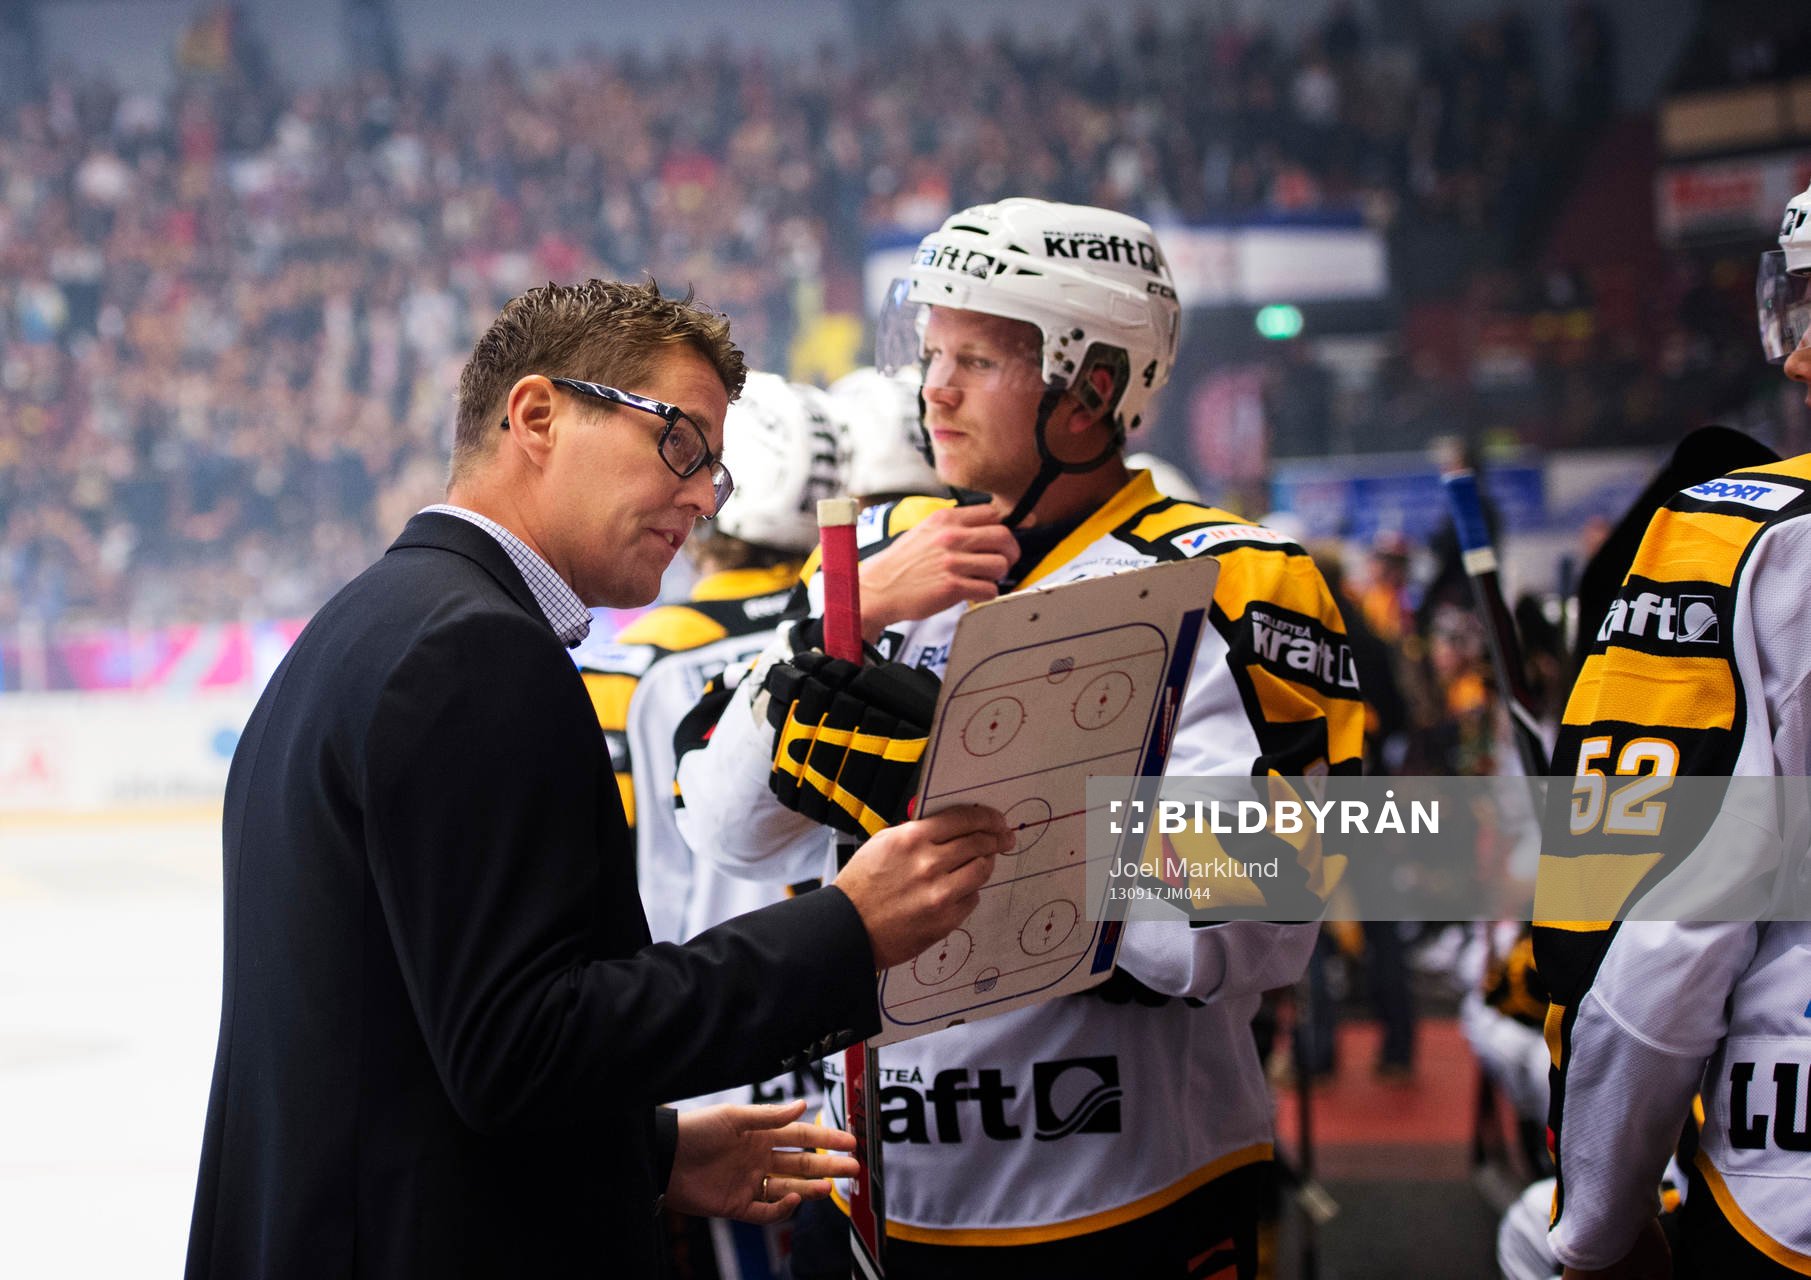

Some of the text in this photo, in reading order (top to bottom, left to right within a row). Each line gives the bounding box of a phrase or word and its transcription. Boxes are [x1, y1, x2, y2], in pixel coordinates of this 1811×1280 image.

[1143, 359, 1157, 388] 4
[1690, 482, 1773, 501] SPORT
[1597, 592, 1677, 641] aft
[1569, 736, 1681, 836] 52
